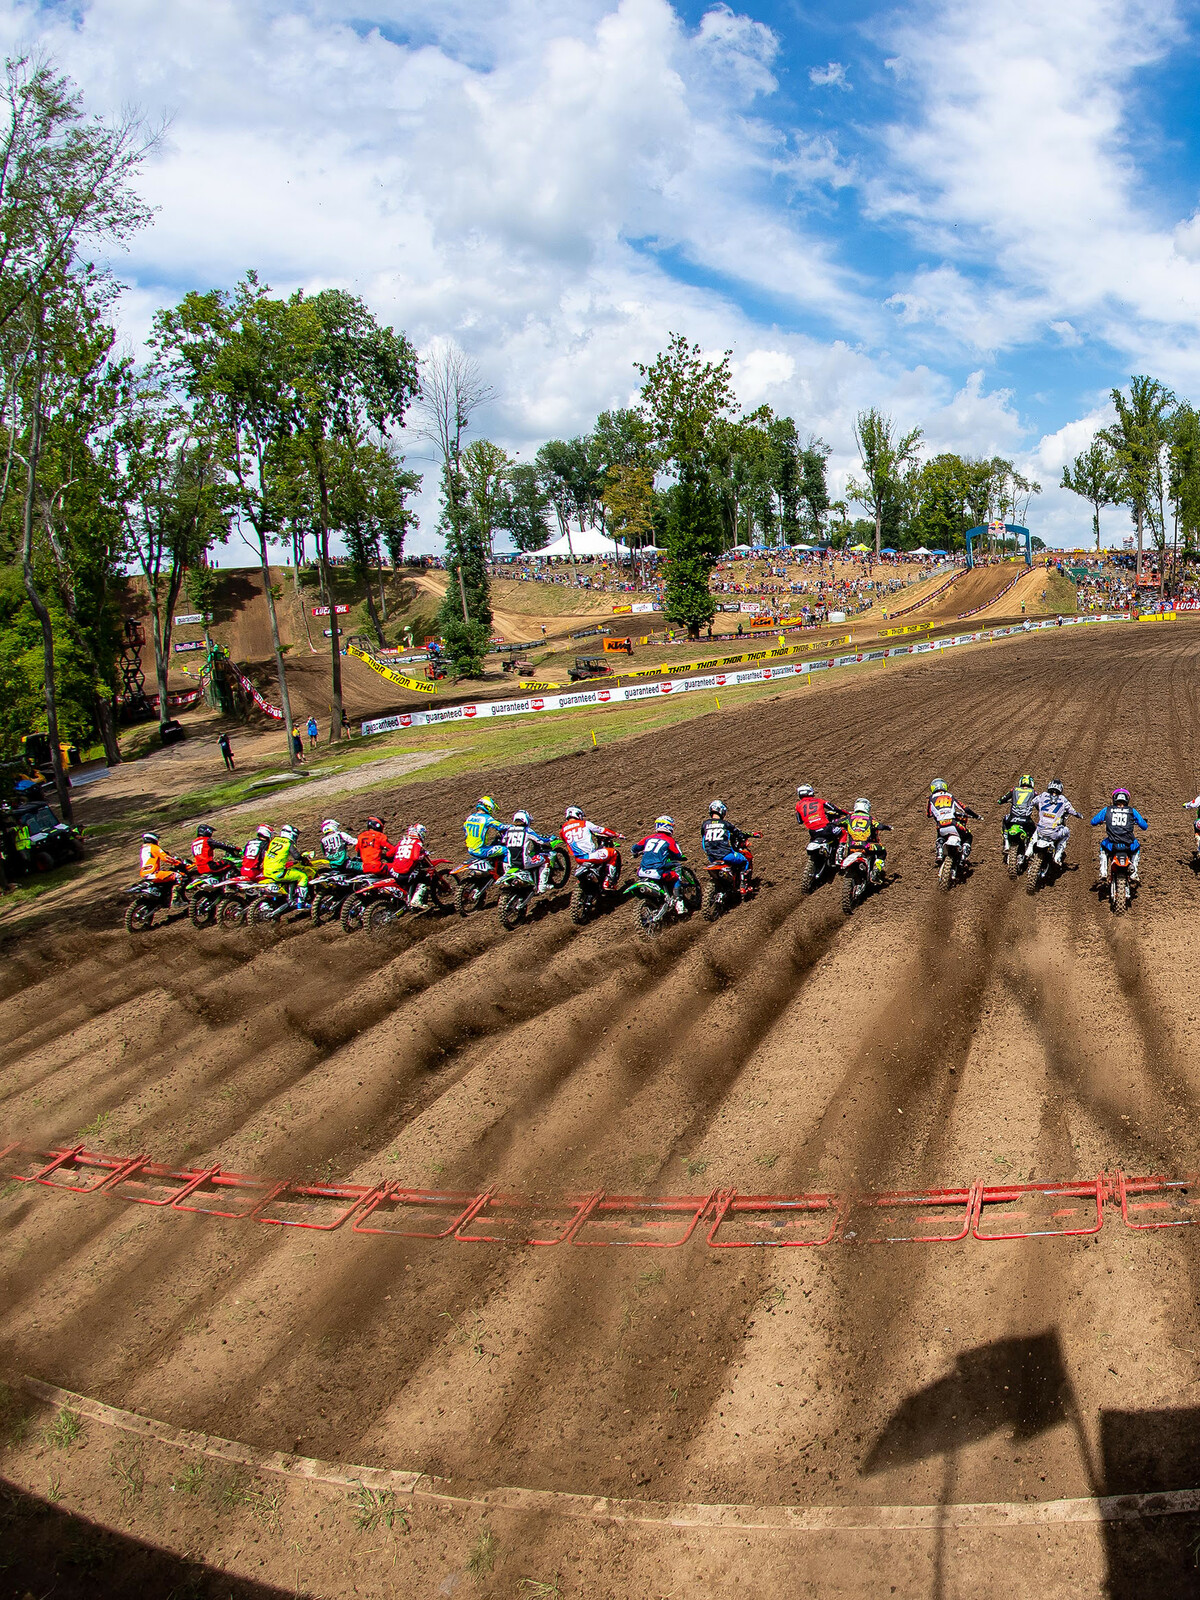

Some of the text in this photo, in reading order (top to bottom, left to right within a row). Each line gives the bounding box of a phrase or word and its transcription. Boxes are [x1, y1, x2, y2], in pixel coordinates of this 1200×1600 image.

[315, 605, 347, 616] LUCA OIL
[1175, 601, 1200, 610] LUCAS
[752, 618, 772, 627] KTM
[697, 660, 718, 669] THOR
[723, 655, 743, 665] THOR
[747, 652, 766, 660] THOR
[770, 648, 789, 657] THOR
[368, 656, 385, 674] THOR
[389, 671, 411, 687] THOR
[365, 717, 399, 734] guaranteed
[425, 708, 463, 724] guaranteed
[464, 707, 476, 715] Rate
[491, 698, 530, 715] guaranteed
[531, 700, 544, 708] Rate
[558, 693, 597, 707] guaranteed
[624, 684, 660, 699] guaranteed
[684, 676, 716, 690] guaranteed
[736, 671, 763, 683] guaranteed
[771, 666, 794, 677] guaranteed
[802, 801, 818, 818] 15
[1041, 799, 1064, 814] 21
[1111, 812, 1128, 827] 503
[466, 823, 480, 839] 711
[705, 828, 725, 842] 412
[507, 831, 524, 848] 269
[645, 838, 666, 855] 61
